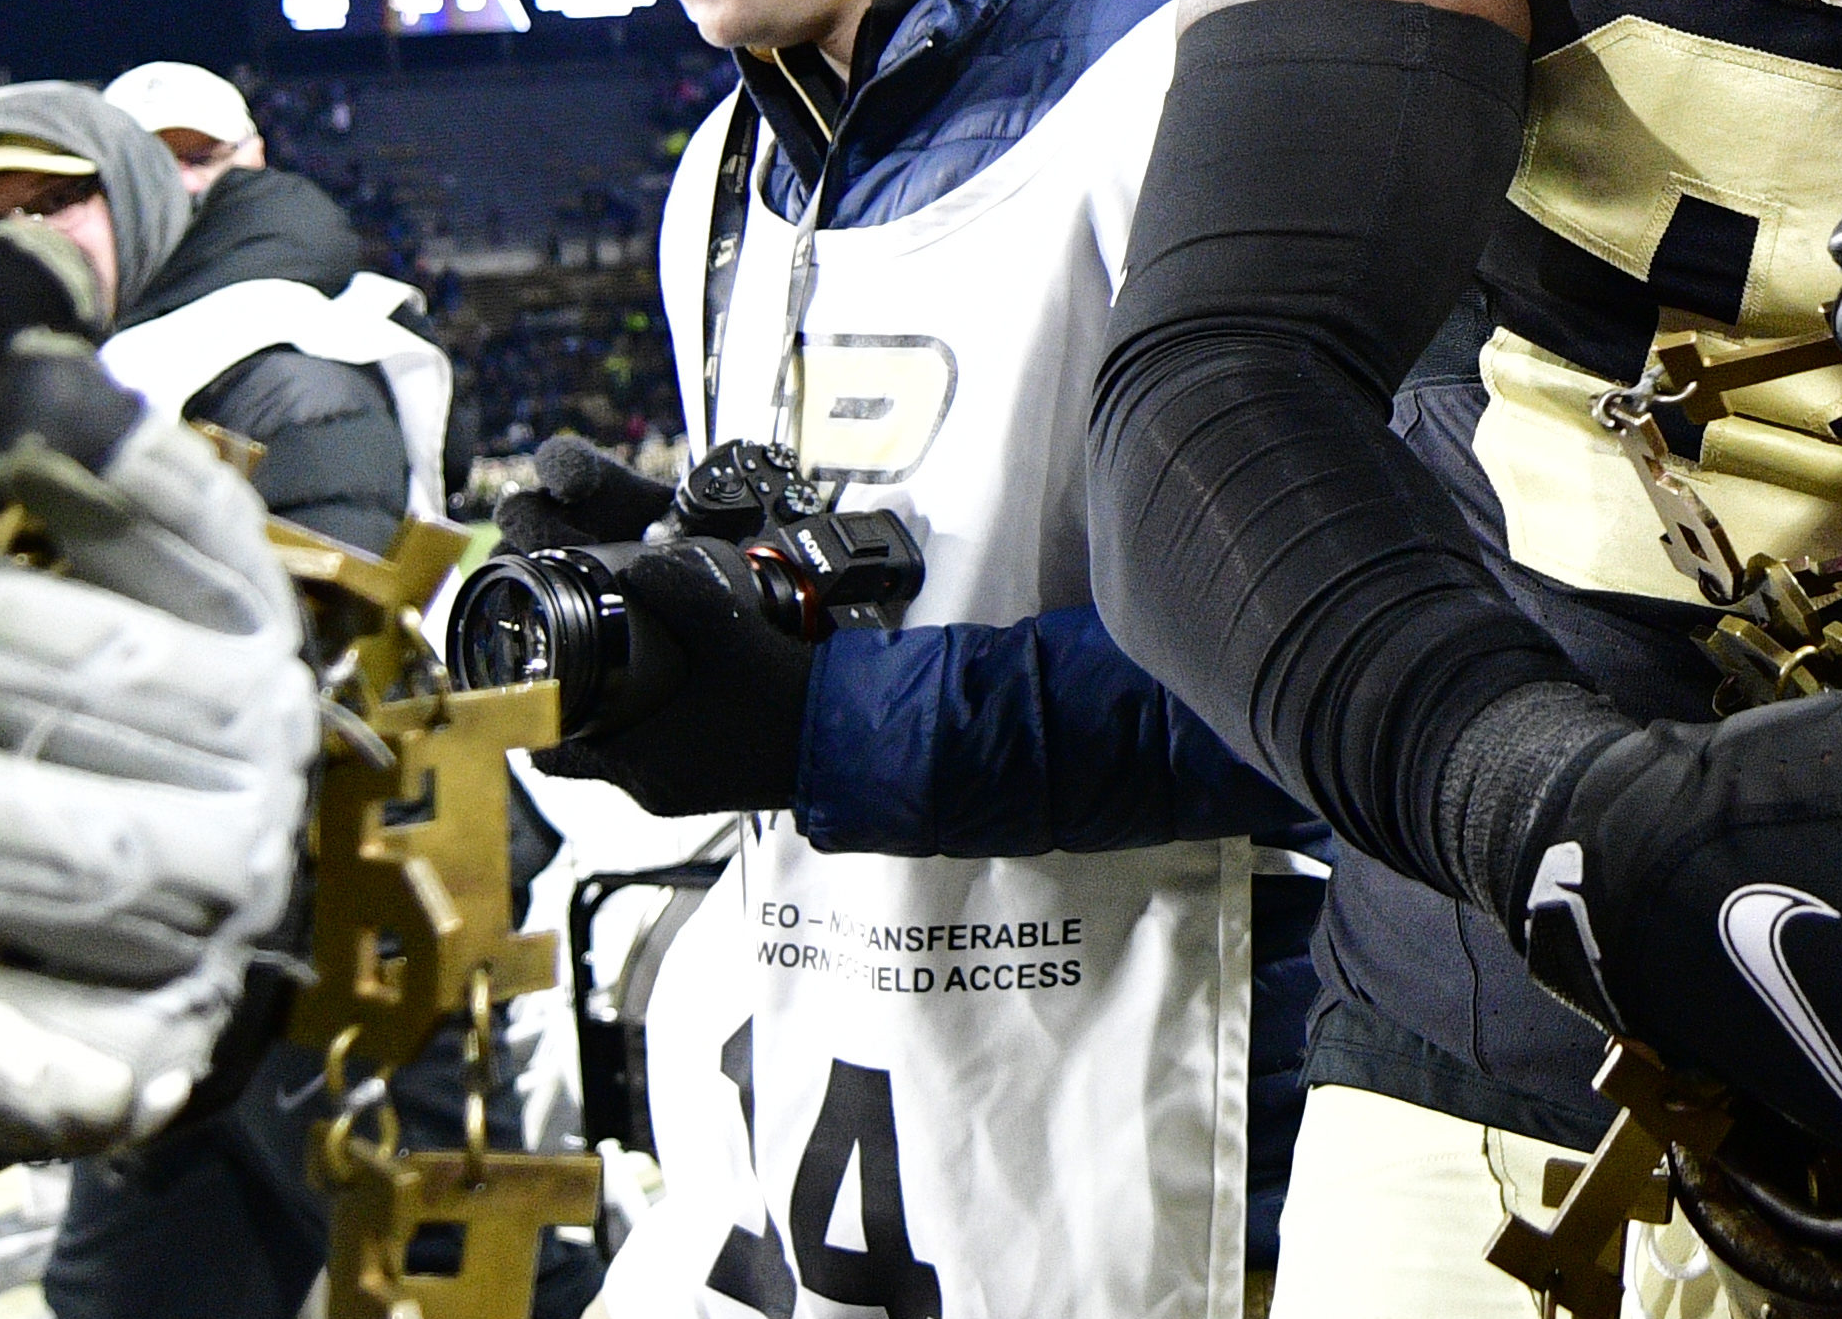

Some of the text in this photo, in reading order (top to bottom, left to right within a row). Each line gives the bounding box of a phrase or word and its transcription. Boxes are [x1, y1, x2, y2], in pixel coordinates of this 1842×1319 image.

[796, 528, 833, 575] SONY
[755, 902, 800, 929] EO
[757, 941, 832, 971] WORN
[943, 959, 1082, 993] ACCESS
